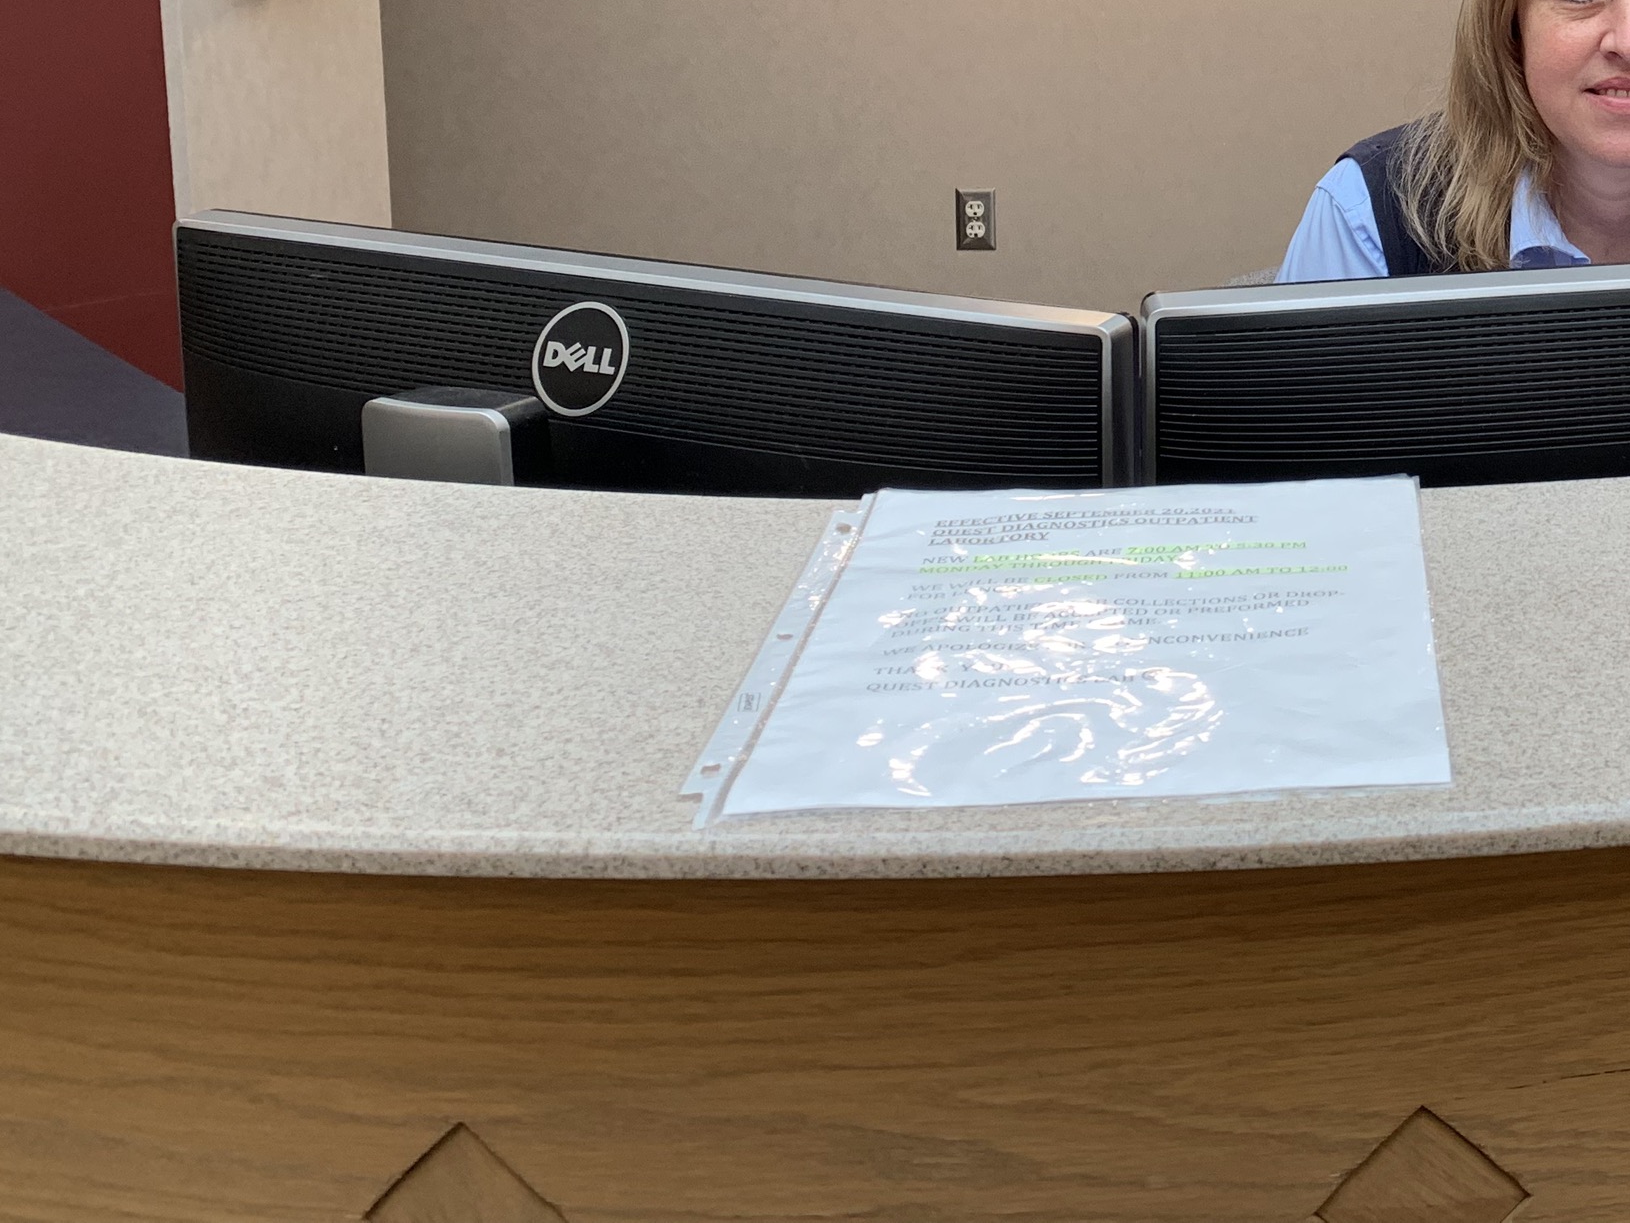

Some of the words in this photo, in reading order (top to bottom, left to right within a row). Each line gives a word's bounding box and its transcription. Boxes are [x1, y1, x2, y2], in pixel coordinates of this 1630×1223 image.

[542, 341, 615, 375] DELL
[931, 526, 993, 538] QUEST
[1000, 517, 1130, 533] DIAGNOSTICS
[1134, 514, 1260, 527] OUTPATIENT
[935, 511, 1039, 527] EFFECTIVE
[1042, 508, 1155, 521] SEPTEMBER
[928, 531, 1051, 547] LABORTORY
[922, 555, 967, 565] NEW
[1085, 548, 1122, 557] ARE
[1127, 546, 1167, 555] 7:00
[1169, 544, 1200, 554] AM
[1279, 540, 1307, 549] PM
[919, 562, 1003, 574] MONDAY
[1009, 559, 1104, 568] THROUGH
[911, 583, 943, 592] WE
[949, 577, 998, 589] WILL
[1003, 576, 1029, 584] BE
[1033, 574, 1108, 584] CLOSED
[1113, 571, 1169, 580] FROM
[1176, 569, 1226, 579] 11:00
[1231, 567, 1260, 576] AM
[1266, 565, 1292, 574] TO
[907, 592, 946, 600] FOR
[933, 601, 1062, 615] OUTPATIE
[1113, 594, 1248, 607] COLLECTIONS
[1252, 591, 1281, 601] OR
[955, 615, 1008, 623] WILL
[1154, 607, 1182, 616] OR
[1187, 599, 1310, 614] PREFORMED
[891, 624, 971, 638] DURING
[976, 623, 1024, 633] THIS
[883, 648, 915, 657] WE
[922, 642, 1040, 653] APOLOGIZE
[1144, 627, 1309, 645] NCONVENIENCE
[873, 664, 950, 675] THAK
[961, 662, 1004, 673] YU
[866, 681, 939, 693] QUEST
